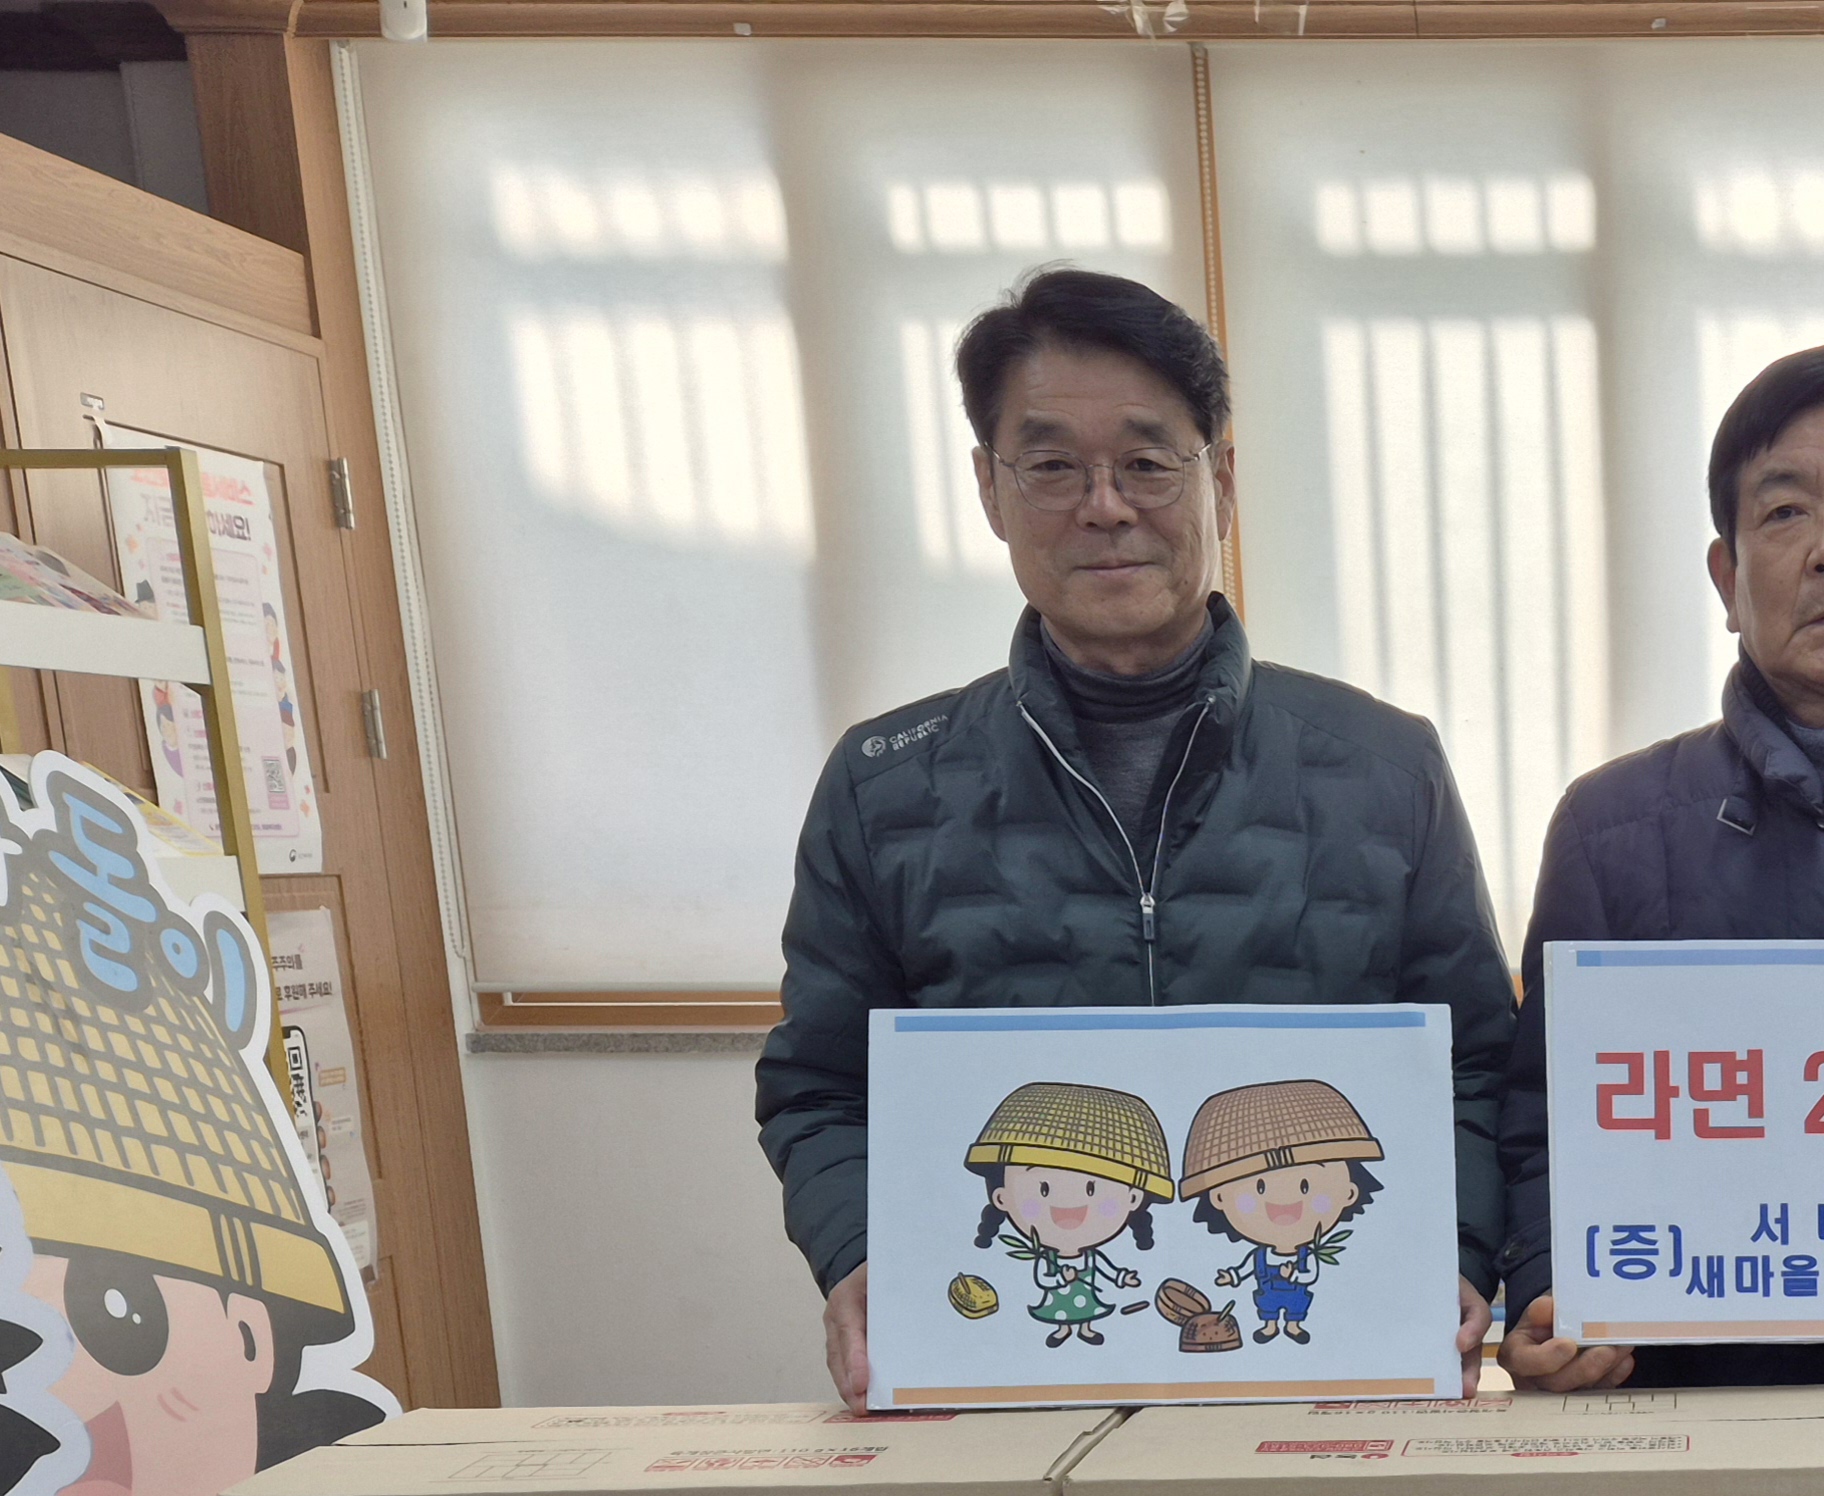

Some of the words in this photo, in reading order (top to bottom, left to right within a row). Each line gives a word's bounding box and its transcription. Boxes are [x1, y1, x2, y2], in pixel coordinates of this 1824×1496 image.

[889, 713, 948, 743] CALIFORNIA
[892, 724, 939, 751] REPUBLIC
[1596, 1048, 1765, 1140] 라면
